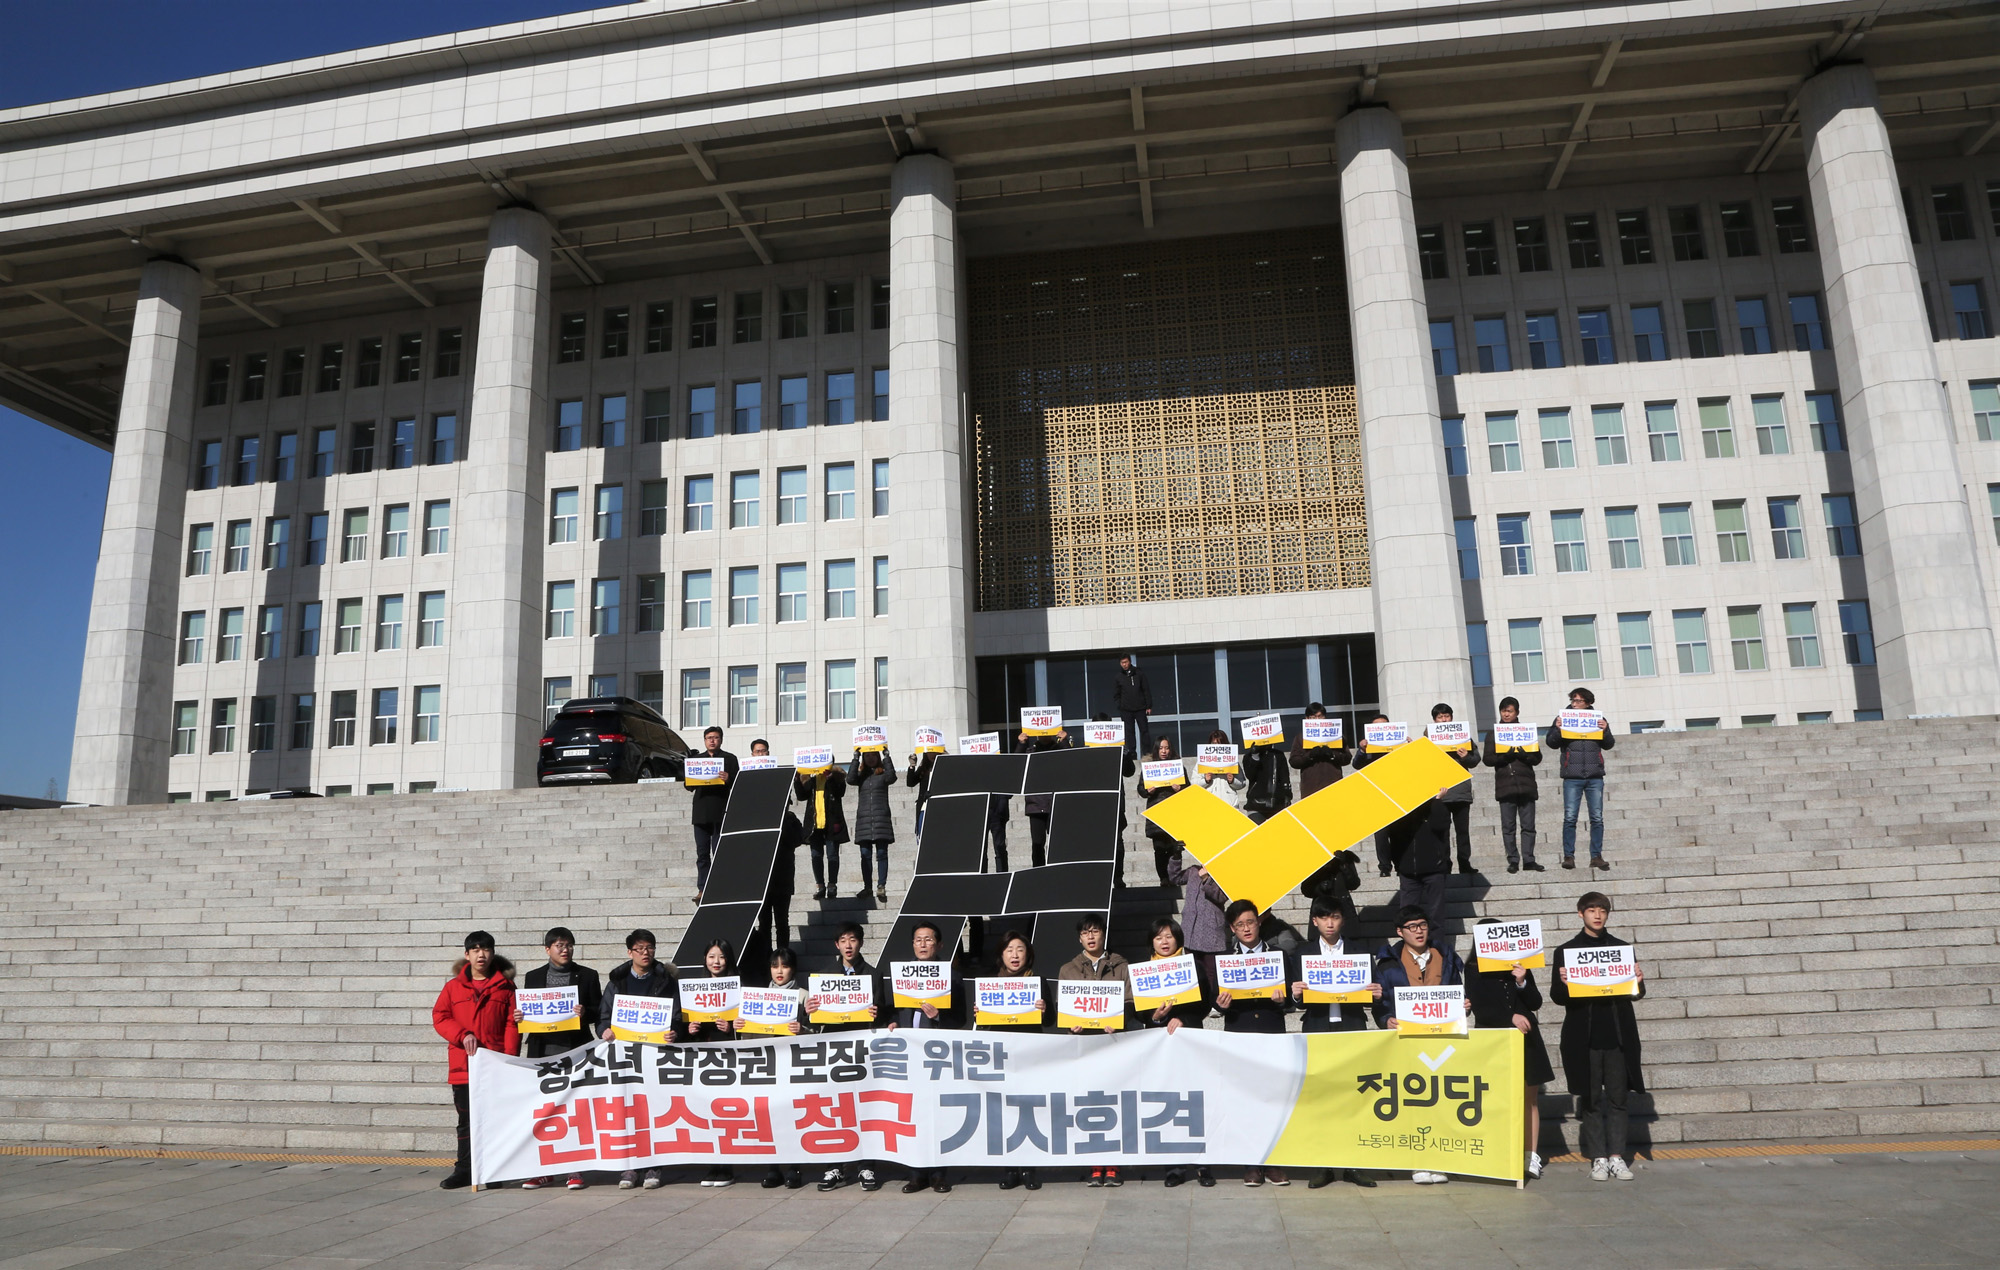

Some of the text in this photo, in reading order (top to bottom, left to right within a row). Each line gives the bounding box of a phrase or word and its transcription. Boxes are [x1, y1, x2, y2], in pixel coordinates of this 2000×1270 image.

[1031, 716, 1053, 727] 삭제!
[1563, 718, 1598, 728] 헌법 소원
[858, 726, 882, 735] 선거연령
[1251, 724, 1272, 737] 삭제!
[1306, 728, 1340, 738] 헌법 소원!
[1435, 723, 1463, 733] 선거연령
[1093, 731, 1115, 741] 삭제!
[1368, 731, 1405, 742] 헌법 소원!
[1498, 732, 1534, 741] 헌법 소원!
[969, 743, 991, 754] 삭제!
[1205, 746, 1232, 755] 선거연령
[797, 754, 829, 764] 헌법 소원!
[688, 766, 703, 776] 헌법
[1146, 767, 1180, 778] 헌법 소원!
[1486, 923, 1530, 940] 선거연령
[1479, 938, 1539, 954] 만18세로 인하!
[1219, 959, 1245, 968] 청소년의
[1244, 956, 1270, 966] 평등권을
[1576, 949, 1622, 965] 선거연령
[1132, 965, 1157, 977] 청소년의
[1156, 962, 1182, 973] 평등권을
[1305, 960, 1332, 969] 청소년의
[1332, 959, 1358, 969] 참정권을
[901, 965, 940, 978] 선거연령
[1222, 965, 1279, 984] 헌법 소원!
[1307, 969, 1366, 985] 헌법 소원!
[1569, 964, 1631, 978] 만18세로 인하!
[681, 981, 738, 992] 정당가입 연령제한
[820, 979, 861, 992] 선거연령
[895, 979, 947, 991] 만18세로 인하!
[979, 982, 1004, 991] 청소년의
[1003, 982, 1029, 991] 참정권을
[1135, 969, 1192, 992] 헌법 소원!
[743, 991, 763, 1000] 청소년의
[763, 992, 787, 1001] 참정권을
[1061, 985, 1122, 995] 정당가입 연령제한
[1397, 991, 1461, 1001] 정당가입 연령제한
[518, 993, 542, 1001] 청소년의
[541, 992, 566, 1001] 평등권을
[694, 992, 727, 1008] 삭제!
[813, 992, 869, 1005] 만18세로 인하!
[980, 991, 1036, 1006] 헌법 소원!
[521, 1000, 574, 1016] 헌법 소원!
[617, 999, 639, 1009] 청소년의
[639, 1001, 662, 1010] 참정권을
[742, 1001, 793, 1017] 헌법 소원!
[1073, 997, 1109, 1013] 삭제!
[1412, 1002, 1449, 1019] 삭제!
[617, 1008, 667, 1026] 헌법 소원!
[534, 1037, 1008, 1094] 청소년 참정권 보장을 위한
[1356, 1072, 1490, 1127] 정의당
[532, 1090, 1206, 1166] 헌법소원 청구 기자회견
[1357, 1130, 1485, 1156] 노동의 희망 시민의 꿈
